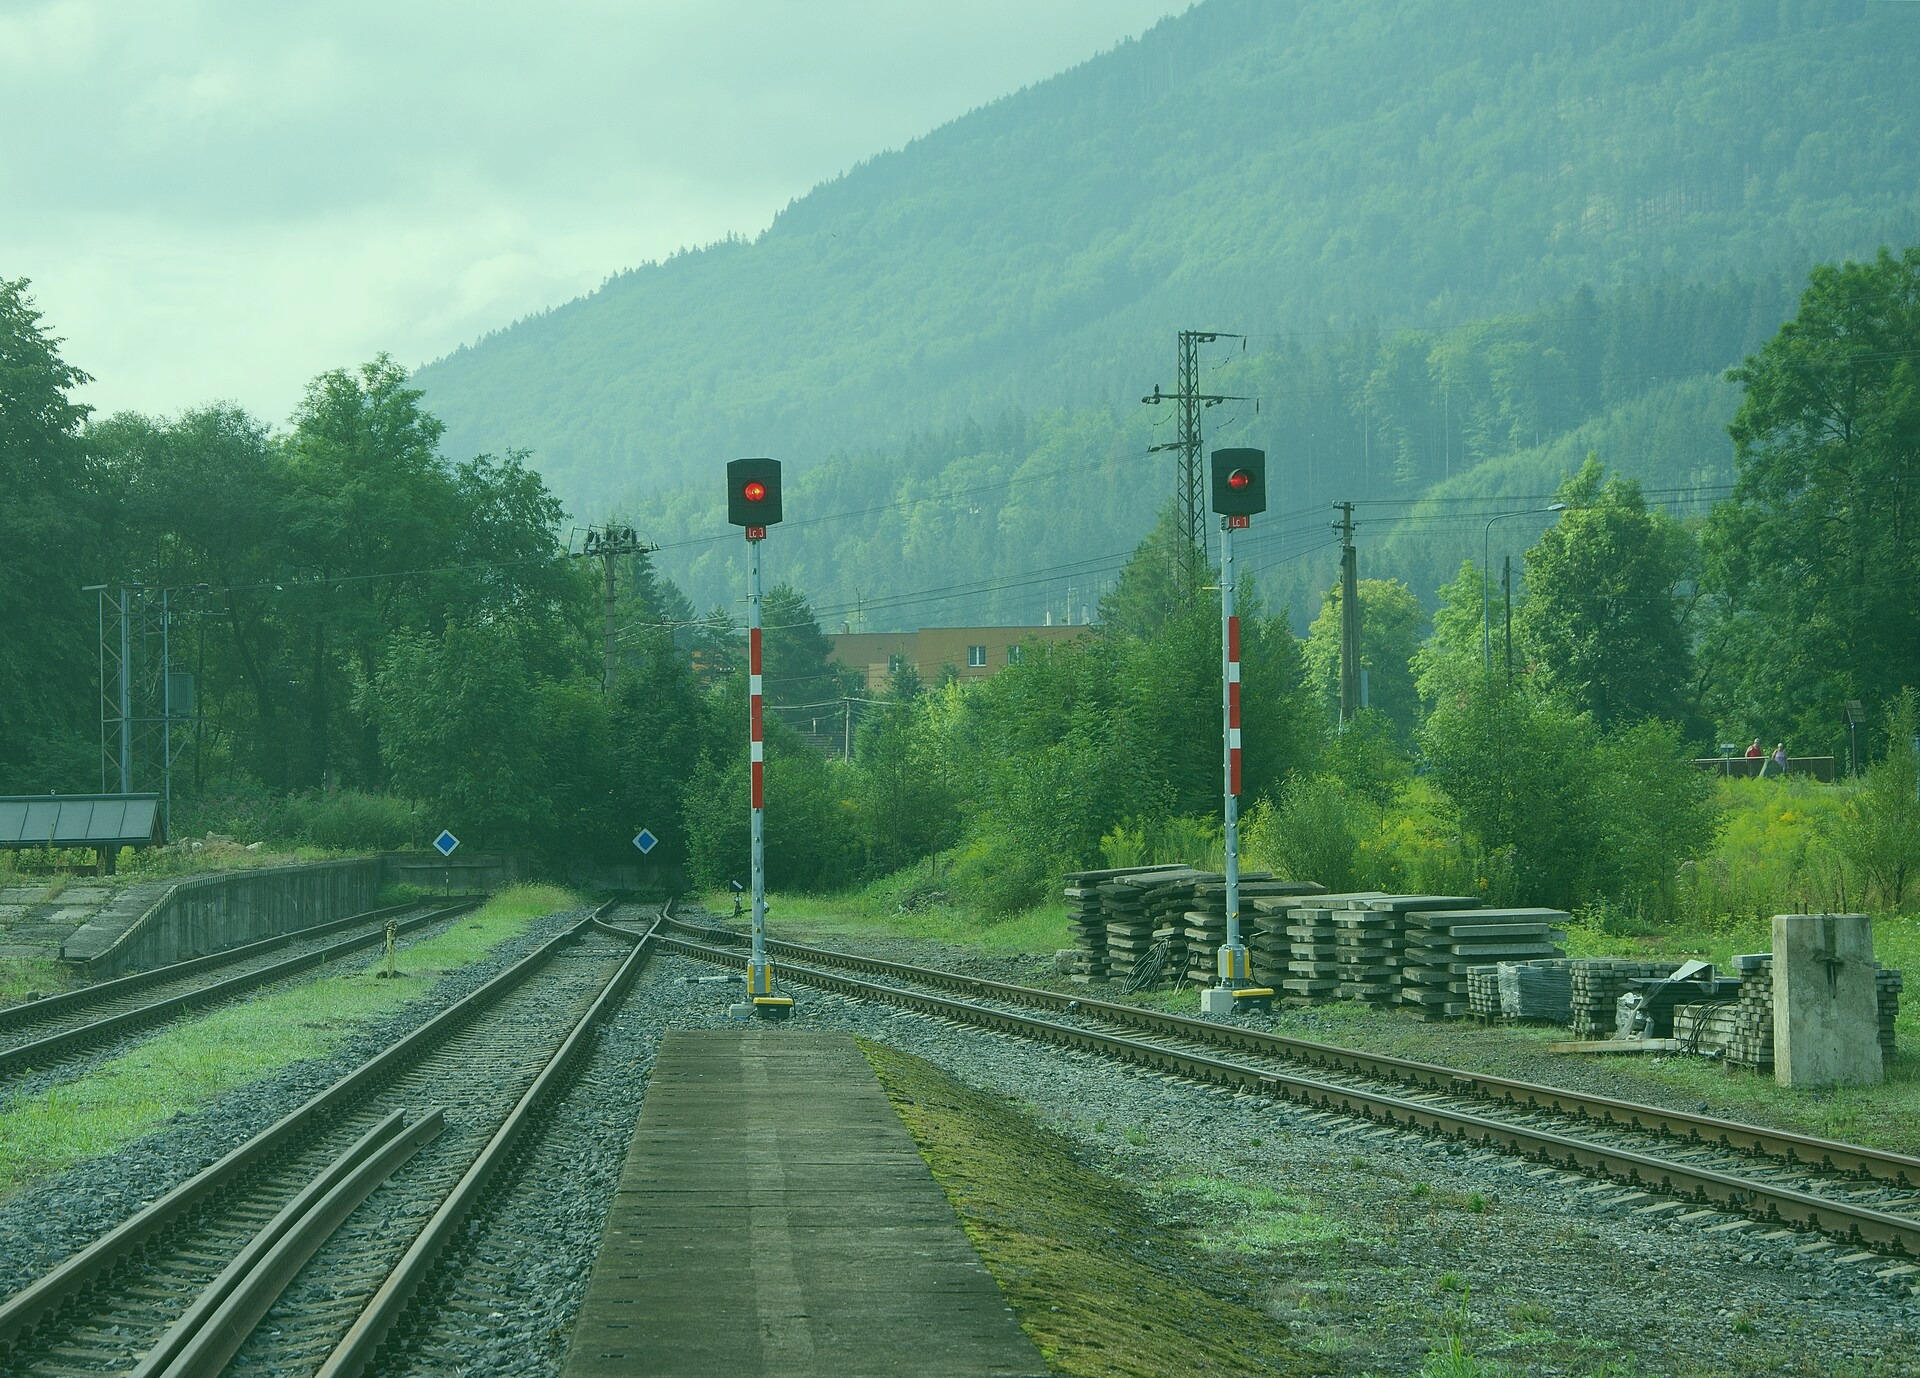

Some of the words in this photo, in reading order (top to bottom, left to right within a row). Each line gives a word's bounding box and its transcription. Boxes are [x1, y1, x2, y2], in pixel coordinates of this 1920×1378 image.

[1242, 517, 1247, 527] 1
[749, 528, 757, 538] Lc
[759, 528, 764, 538] 3
